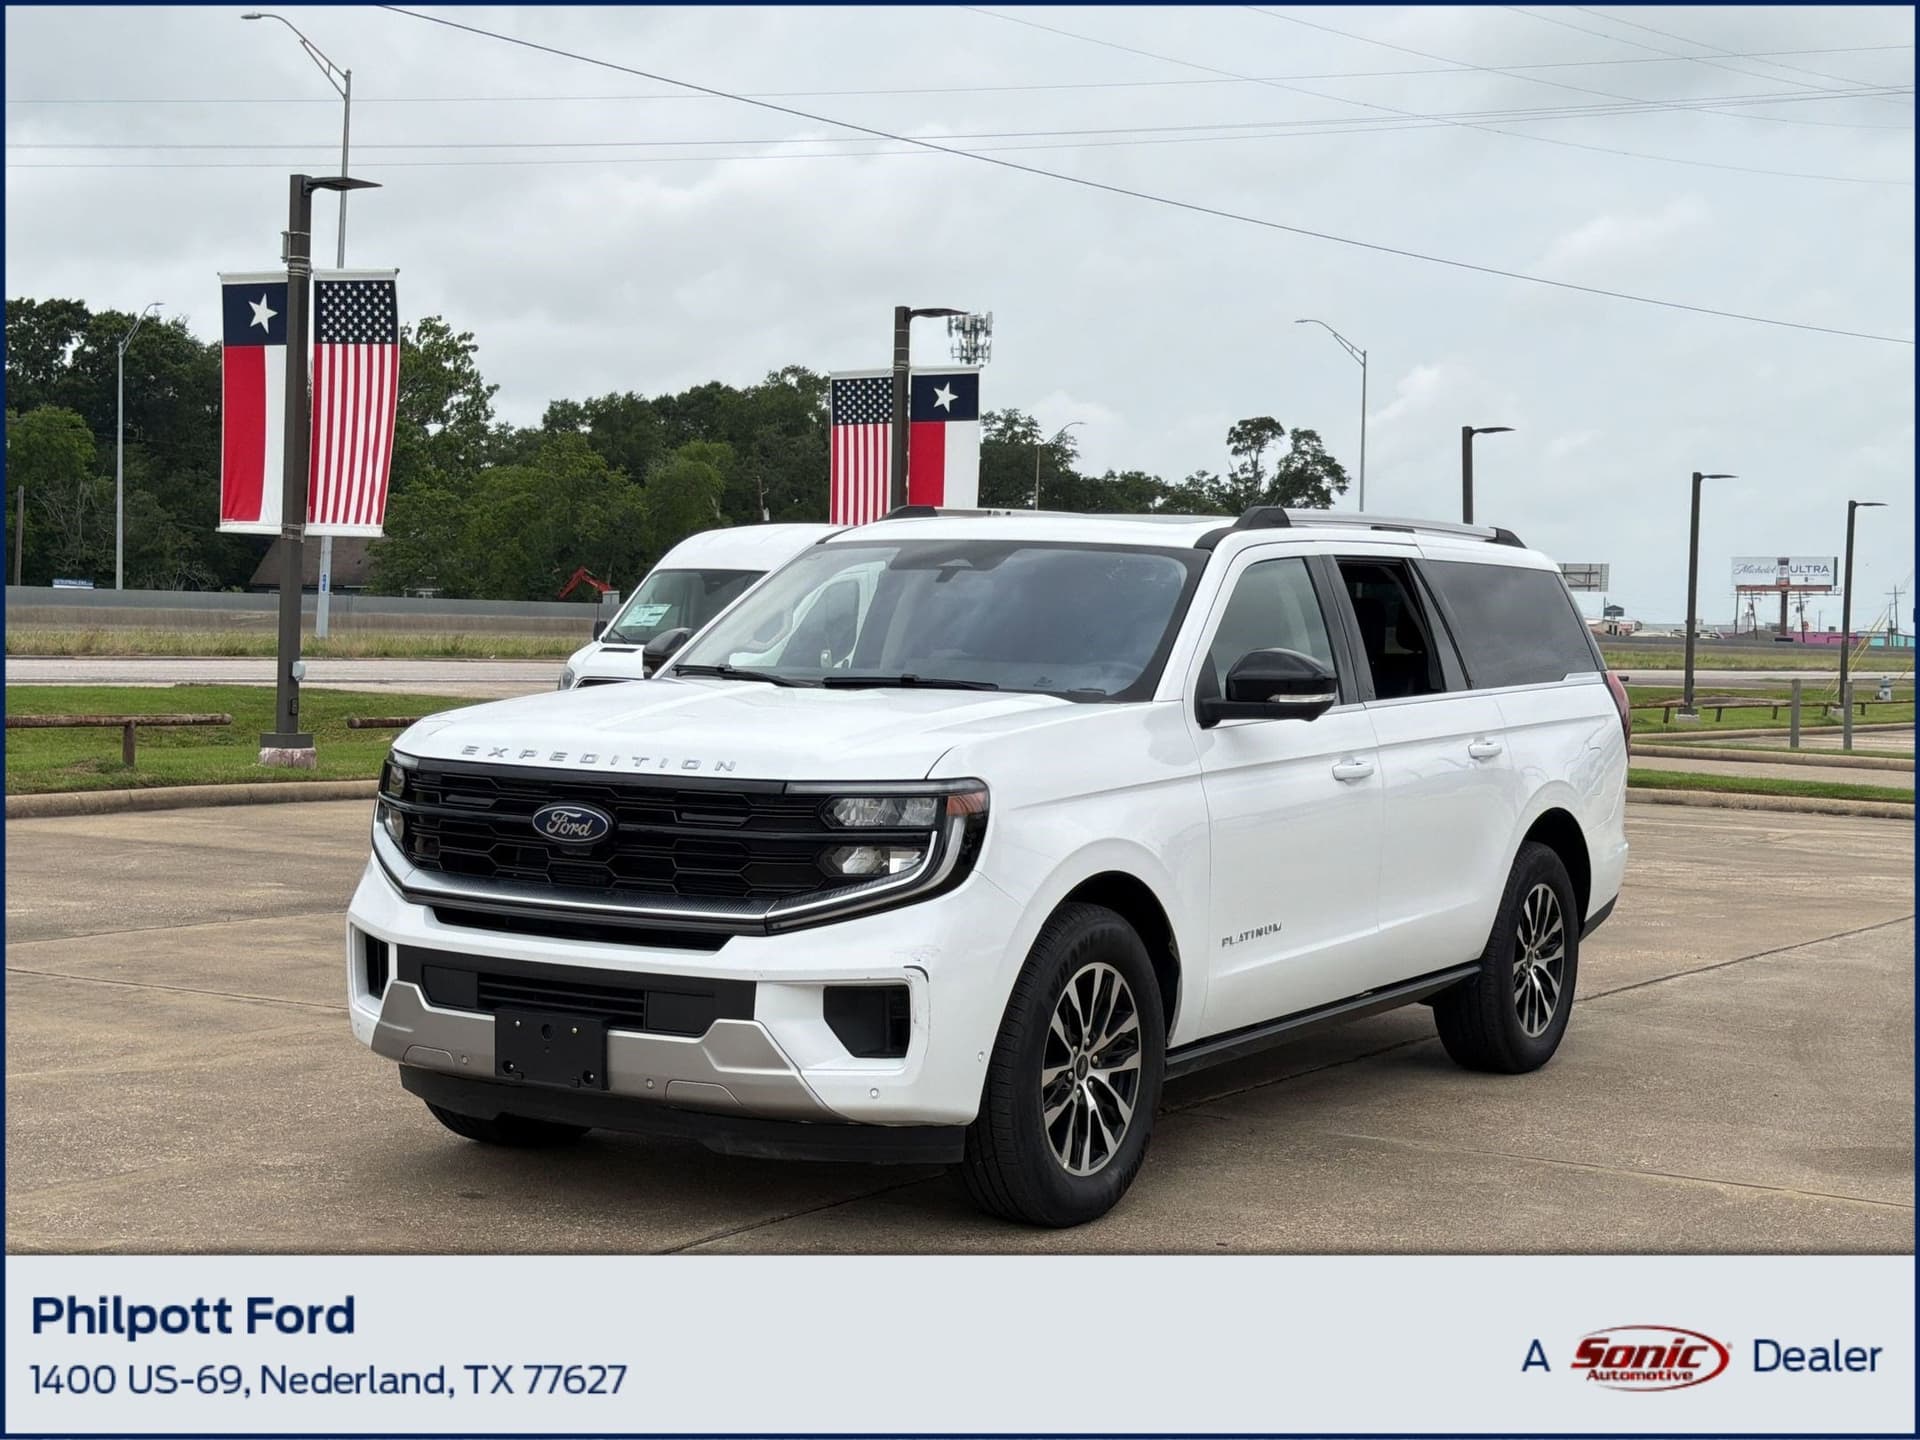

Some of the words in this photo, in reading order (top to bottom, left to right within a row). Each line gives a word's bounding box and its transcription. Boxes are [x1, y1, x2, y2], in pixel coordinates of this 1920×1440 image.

[1790, 565, 1830, 573] ULTRA
[462, 745, 737, 772] EXPEDITION
[546, 810, 593, 837] Ford
[1222, 921, 1282, 947] PLATINUM
